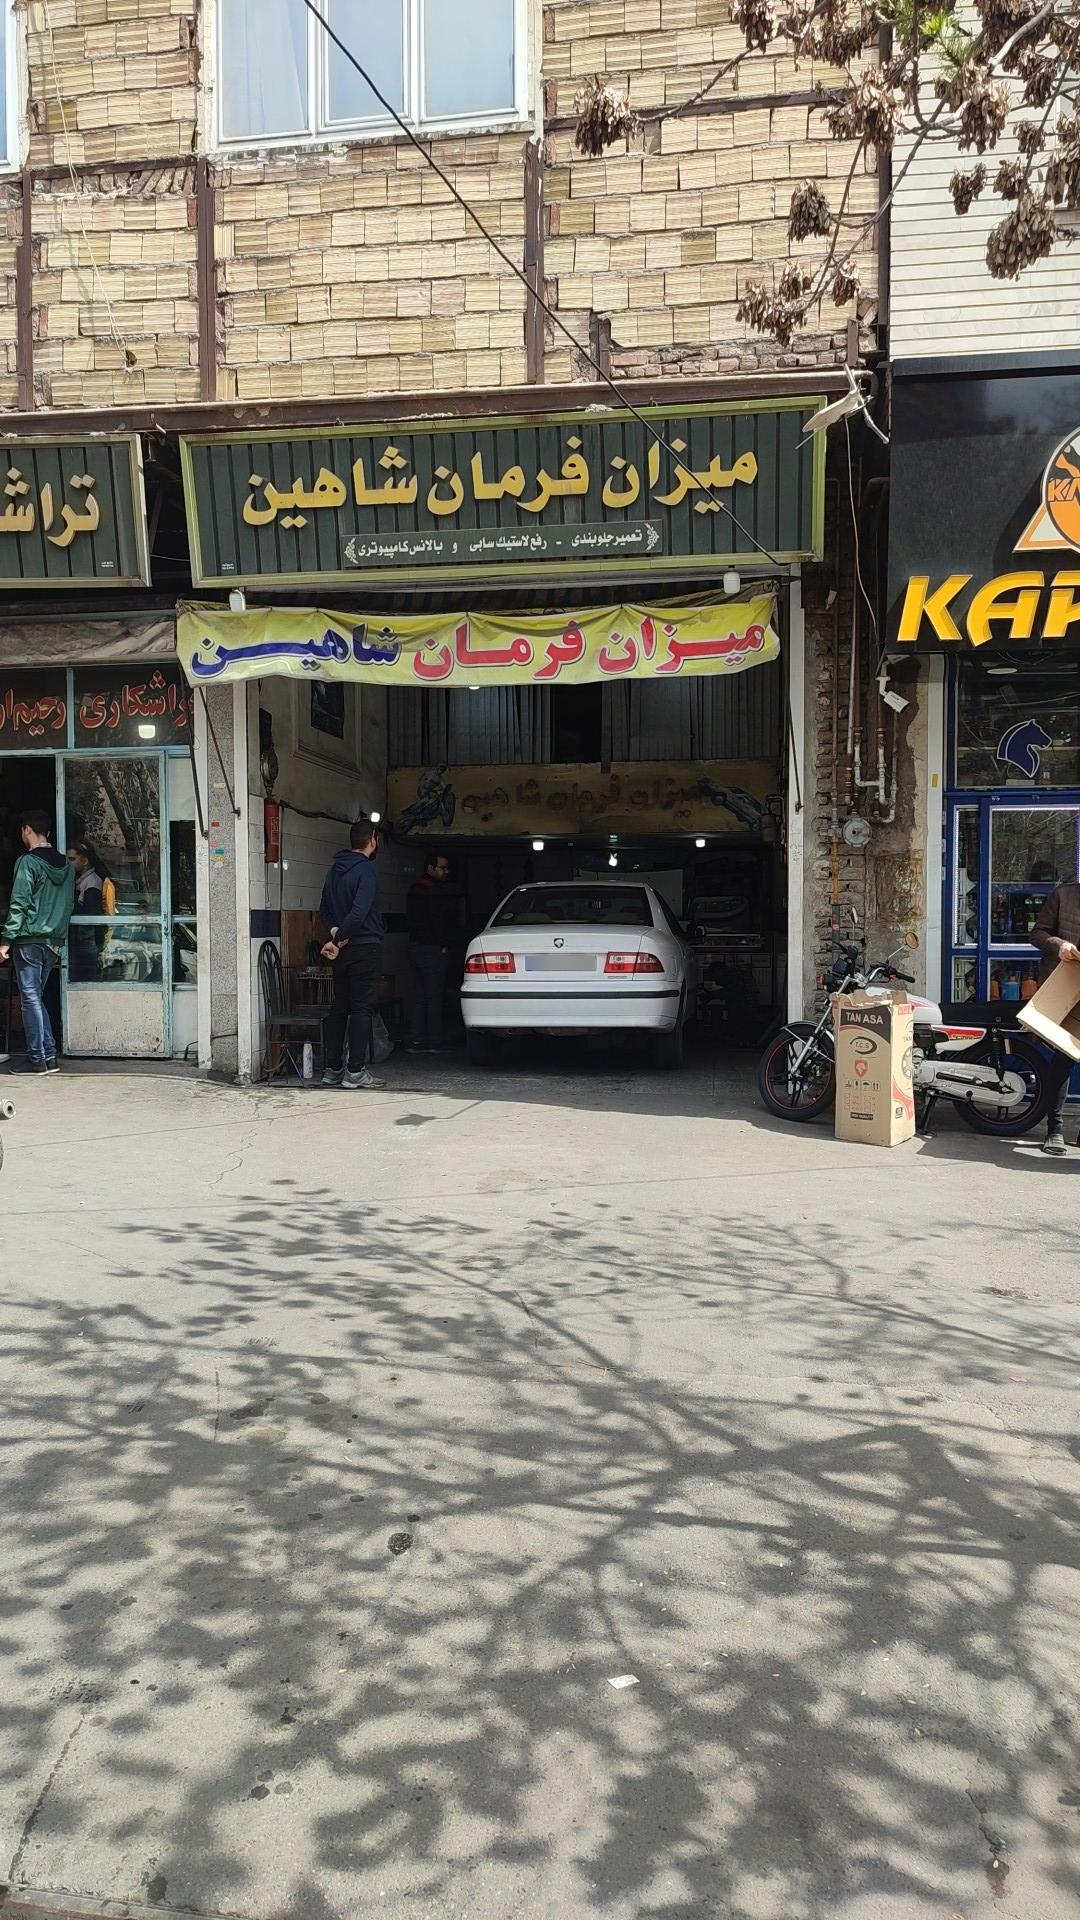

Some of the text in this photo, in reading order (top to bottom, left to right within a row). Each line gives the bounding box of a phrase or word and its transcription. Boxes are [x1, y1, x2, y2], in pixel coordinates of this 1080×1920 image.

[242, 434, 759, 530] میزان فرمان شاهین
[451, 542, 458, 553] و
[191, 616, 767, 681] میزان فرمان شاهین
[79, 670, 194, 729] راشکاری
[846, 1012, 884, 1025] TAN ASA
